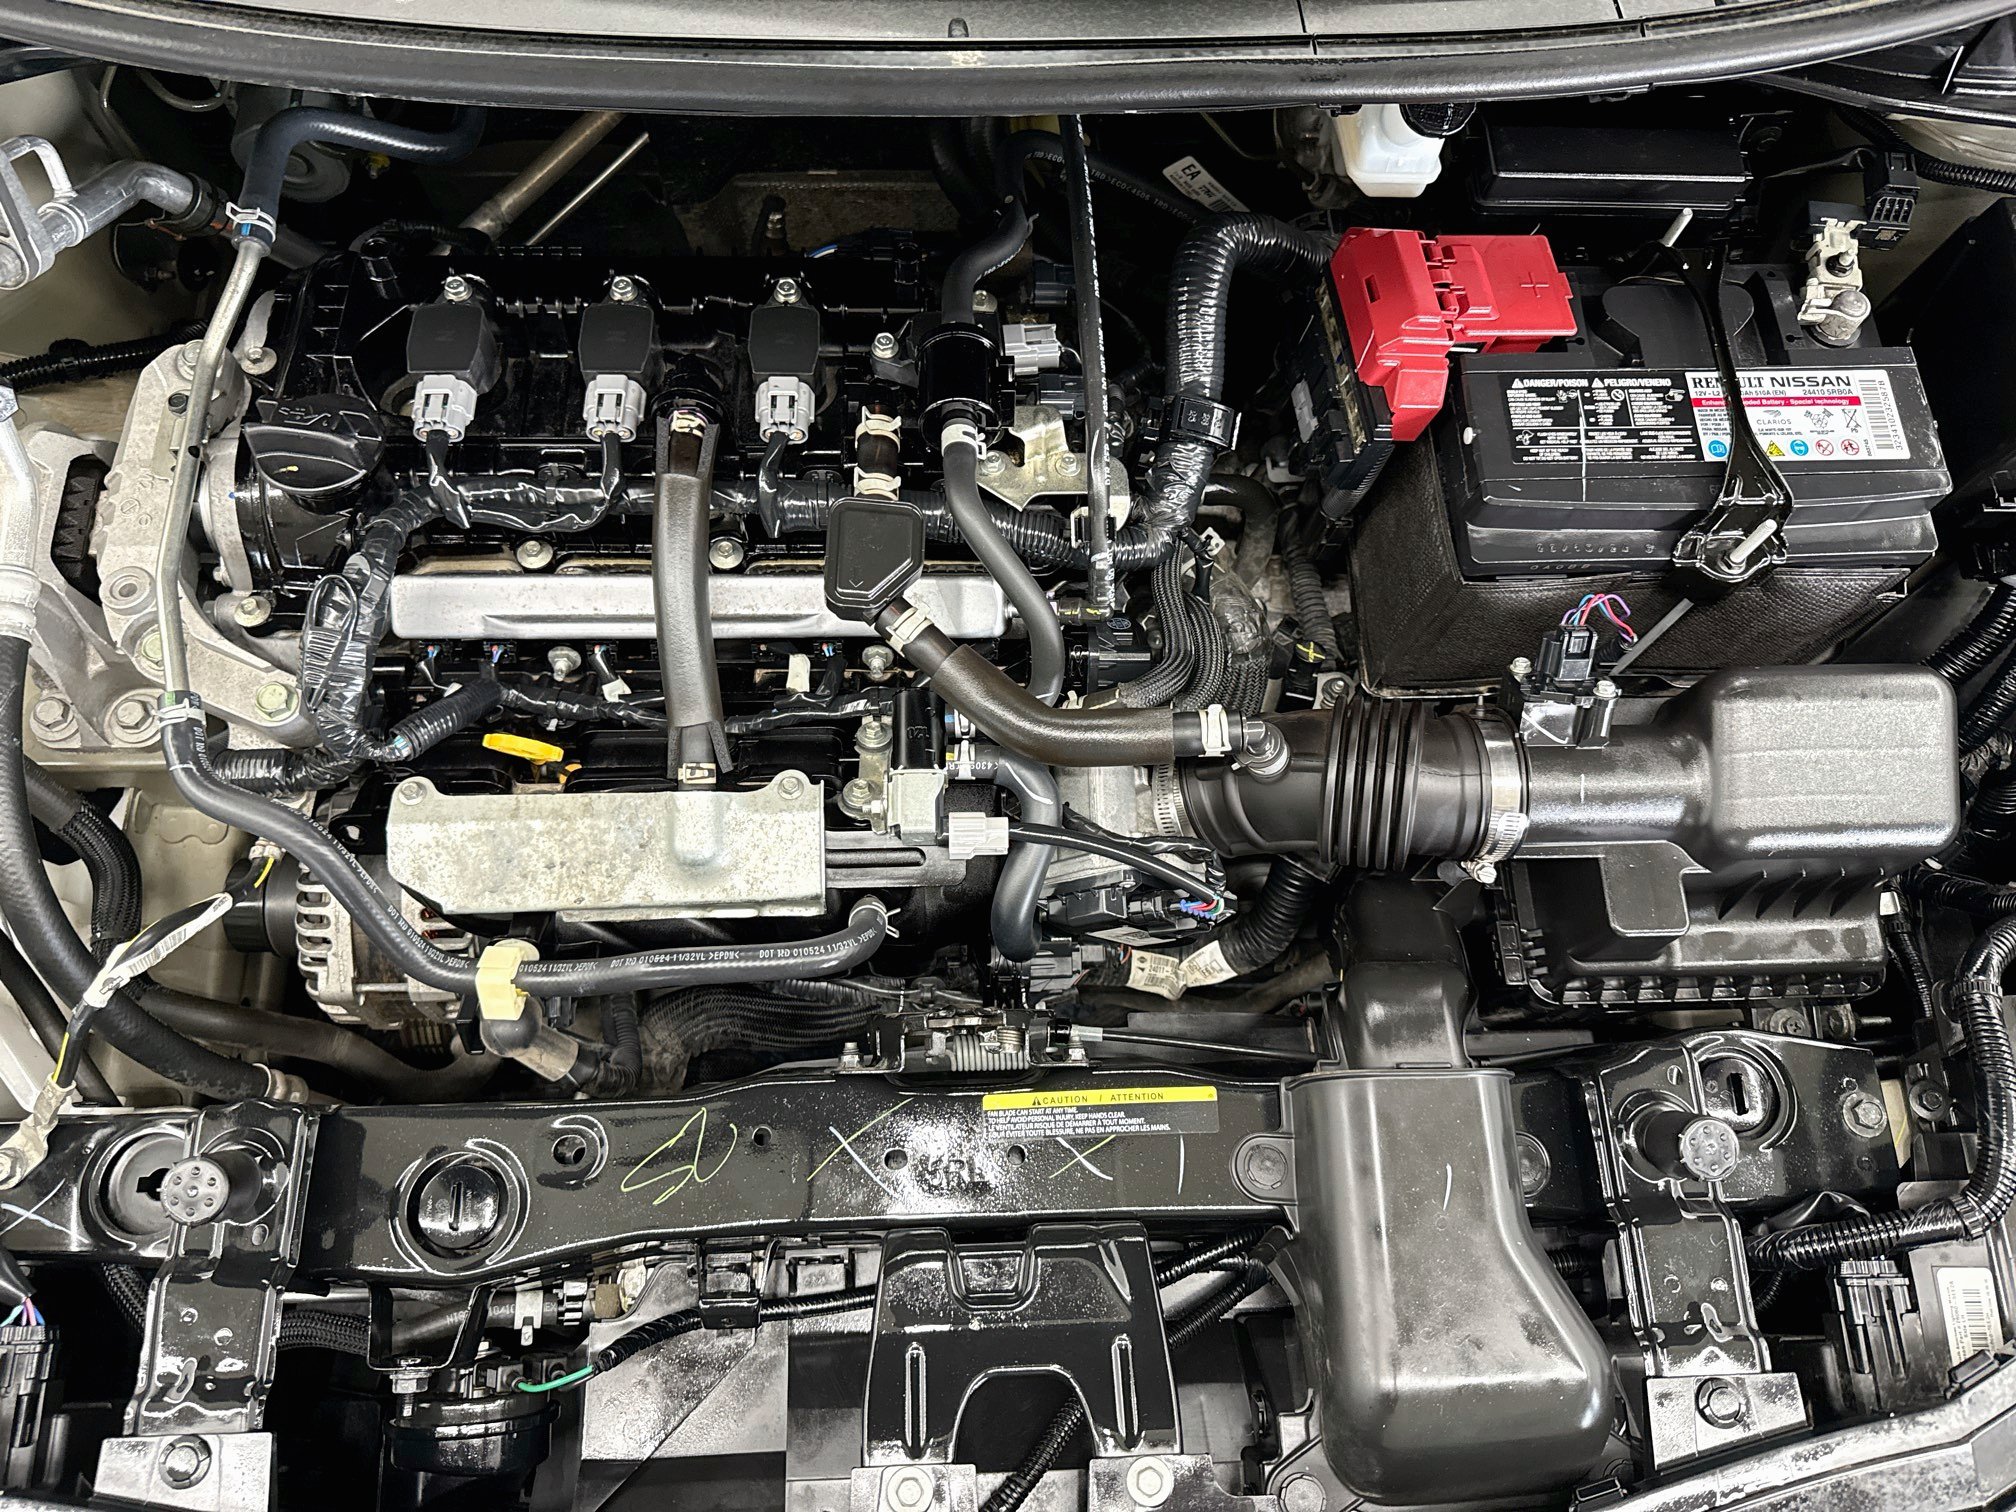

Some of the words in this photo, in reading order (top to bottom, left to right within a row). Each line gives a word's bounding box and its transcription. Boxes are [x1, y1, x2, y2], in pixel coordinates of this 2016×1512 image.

[1181, 164, 1201, 180] EA
[1523, 379, 1589, 388] DANGER/POISON
[1603, 378, 1672, 387] PELIGRO/VENENO
[1770, 376, 1852, 388] NISSAN
[1772, 389, 1787, 397] (EN)
[1814, 398, 1850, 406] technology
[387, 905, 399, 919] DOT
[407, 928, 426, 950] 010524
[759, 949, 775, 959] DOT
[793, 945, 826, 957] 010524
[610, 959, 625, 968] DOT
[639, 954, 670, 964] 010524
[708, 950, 740, 960] >EPDM<
[519, 964, 547, 973] 010524
[1043, 1096, 1088, 1105] CAUTION
[1110, 1092, 1164, 1101] ATTENTION
[999, 1109, 1017, 1117] BLADE
[1017, 1108, 1028, 1116] CAN
[1029, 1107, 1045, 1115] START
[1028, 1114, 1055, 1122] PERSONAL
[996, 1123, 1033, 1132] VENTILATEUR
[1034, 1121, 1055, 1130] RISQUE
[1065, 1119, 1096, 1128] DÉMARRER
[1119, 1117, 1146, 1125] MOMENT.
[1026, 1129, 1044, 1137] TOUTE
[1045, 1127, 1075, 1136] BLESSURE,
[1105, 1125, 1140, 1133] APPROCHER
[1140, 1124, 1150, 1132] LES
[1151, 1123, 1171, 1131] MAINS.
